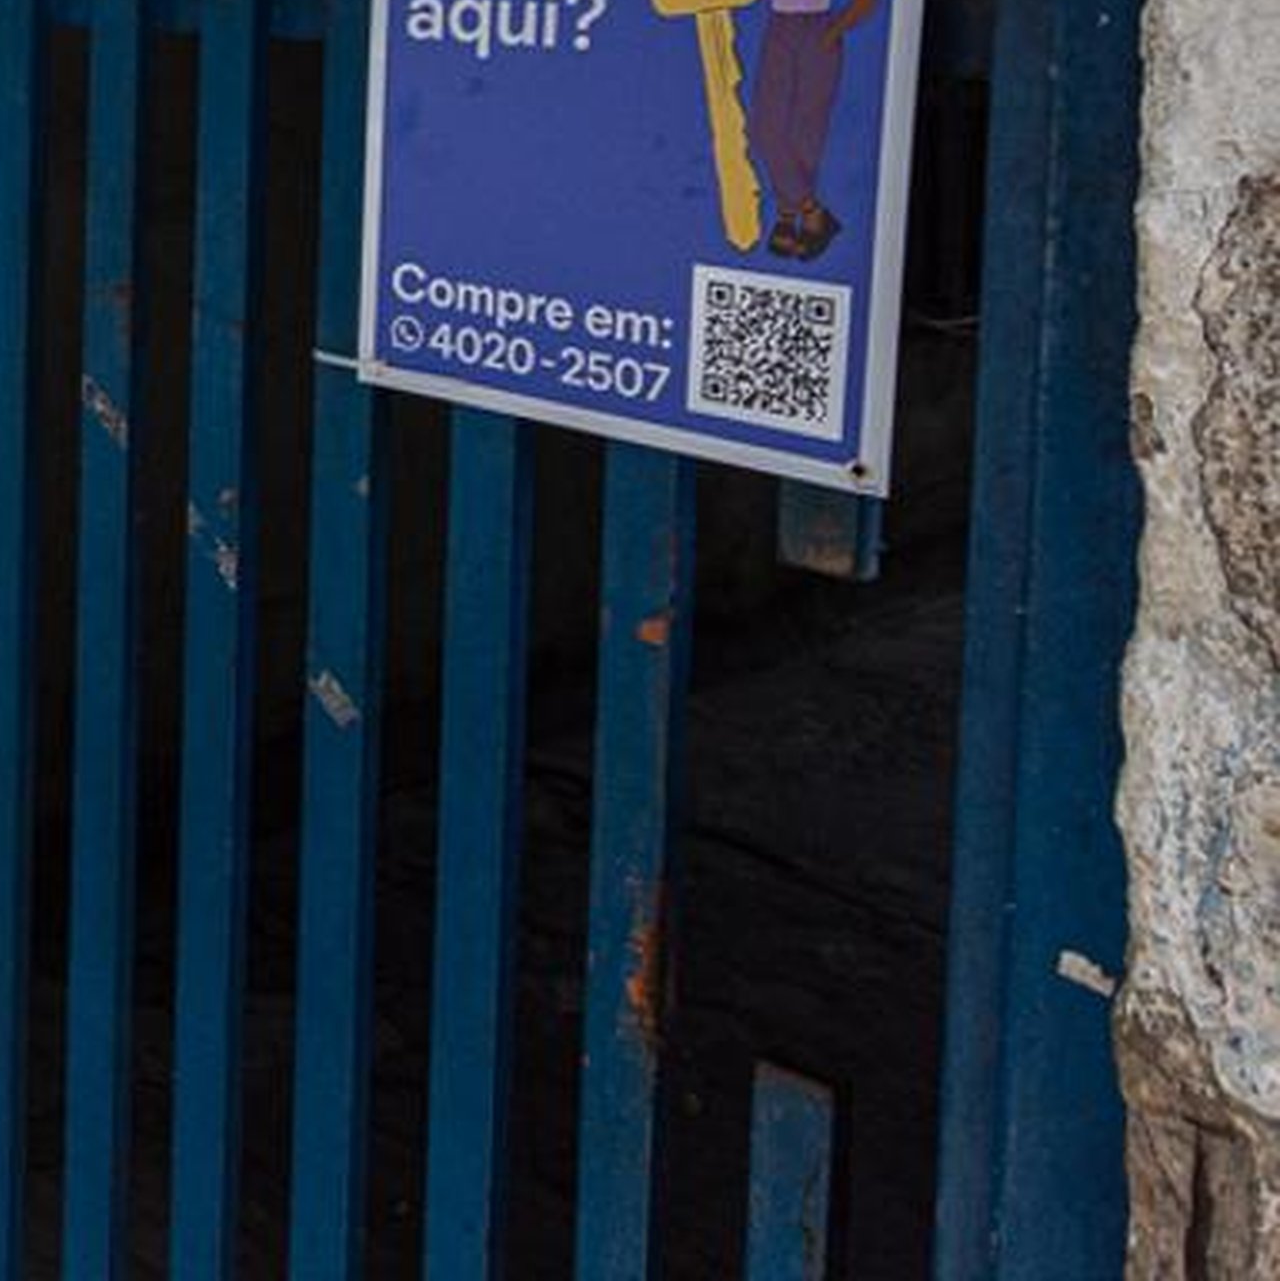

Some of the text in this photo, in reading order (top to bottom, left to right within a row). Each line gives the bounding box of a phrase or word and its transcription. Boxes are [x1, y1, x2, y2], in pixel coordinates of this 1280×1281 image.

[392, 263, 673, 349] Compre em:
[428, 322, 671, 402] 4020-2507
